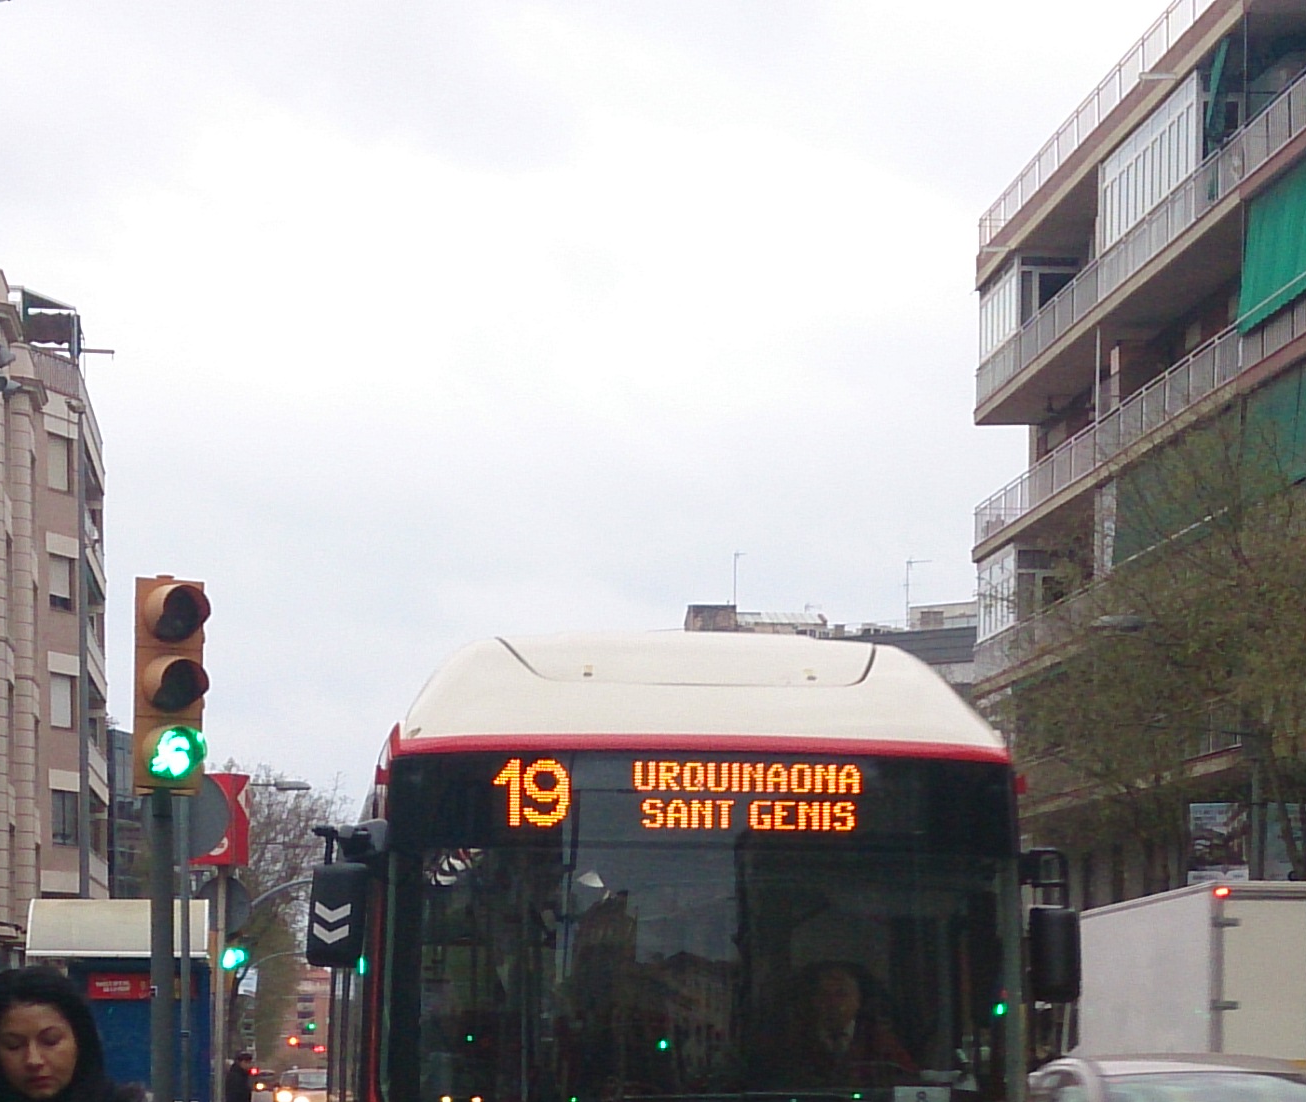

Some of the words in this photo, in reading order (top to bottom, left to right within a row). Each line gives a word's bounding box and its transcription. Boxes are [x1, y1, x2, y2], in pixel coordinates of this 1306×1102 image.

[493, 757, 572, 828] 19
[632, 760, 863, 794] URQUINAONA
[640, 799, 736, 829] SANT
[748, 800, 858, 831] GENIS
